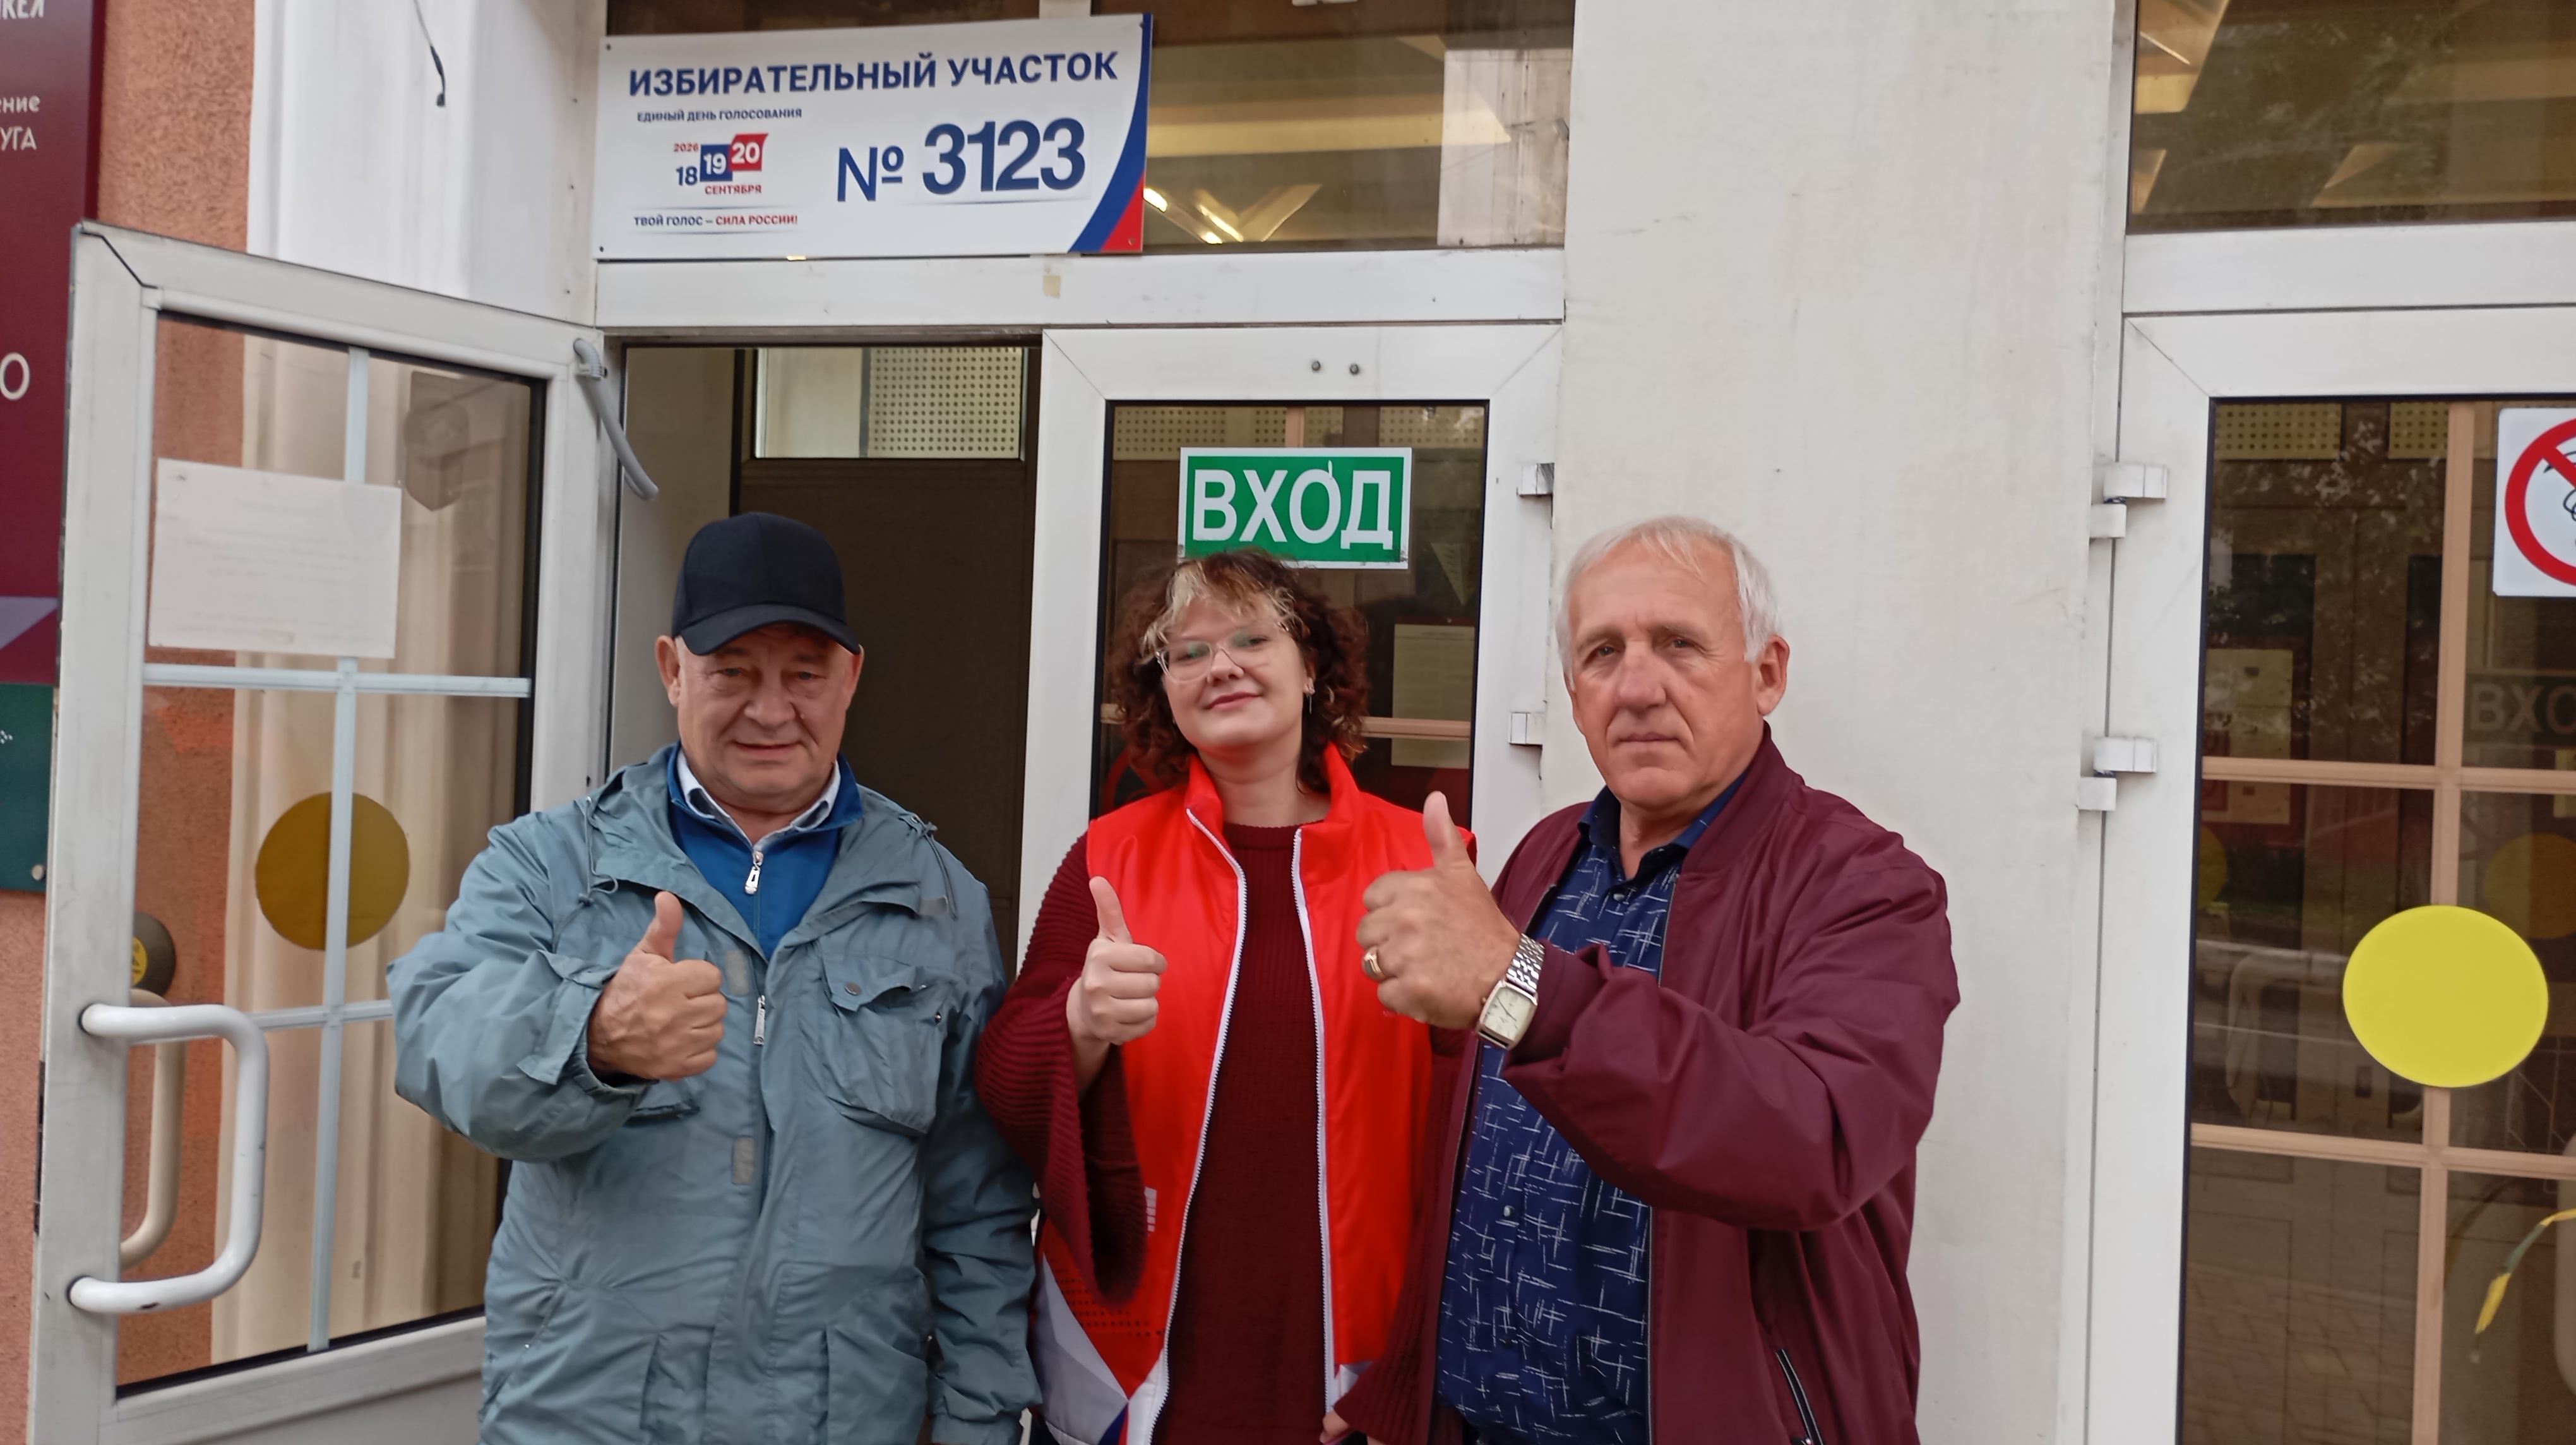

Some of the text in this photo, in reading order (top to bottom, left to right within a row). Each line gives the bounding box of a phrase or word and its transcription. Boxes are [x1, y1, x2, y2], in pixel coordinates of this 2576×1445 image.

[0, 0, 45, 20] КЕЛ
[630, 51, 1118, 96] ИЗБИРАТЕЛЬНЫЙ УЧАСТОК
[0, 95, 40, 113] ние
[637, 108, 802, 123] ЕДИНЫЙ ДЕНЬ ГОЛОСОВАНИЯ
[674, 143, 699, 152] 2026
[922, 117, 1085, 195] 3123
[676, 142, 760, 186] 18 19 20
[705, 184, 762, 195] СЕНТЯБРЯ
[634, 213, 664, 226] ТВОЙ
[667, 216, 703, 226] ГОЛОС
[715, 215, 746, 225] СИЛА
[749, 215, 797, 225] РОССИИ!
[1192, 469, 1393, 550] ВХОД
